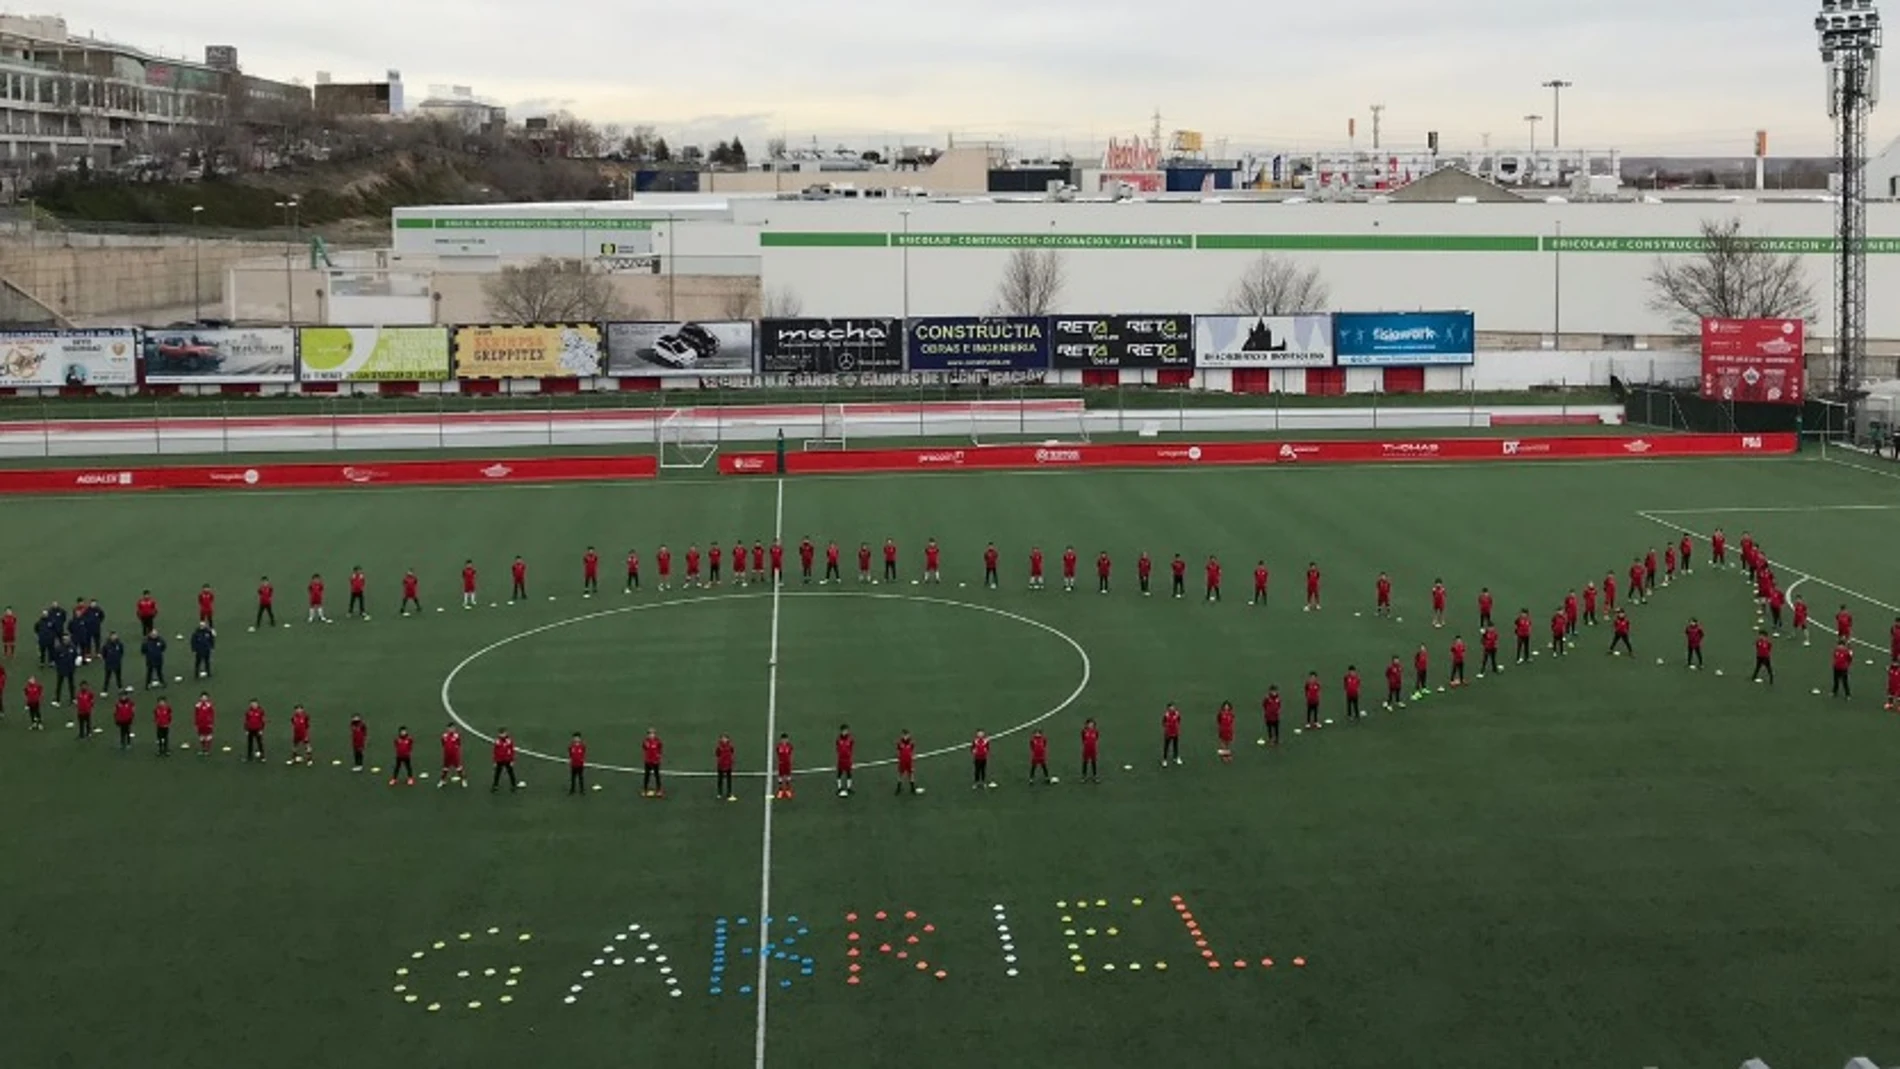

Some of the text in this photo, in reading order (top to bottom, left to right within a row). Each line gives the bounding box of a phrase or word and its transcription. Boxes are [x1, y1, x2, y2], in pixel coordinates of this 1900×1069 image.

[915, 325, 1042, 340] CONSTRUCTIA
[795, 373, 839, 386] SANSE
[860, 371, 919, 386] CAMPOS
[922, 371, 939, 384] DE
[1382, 443, 1438, 451] THOMAS
